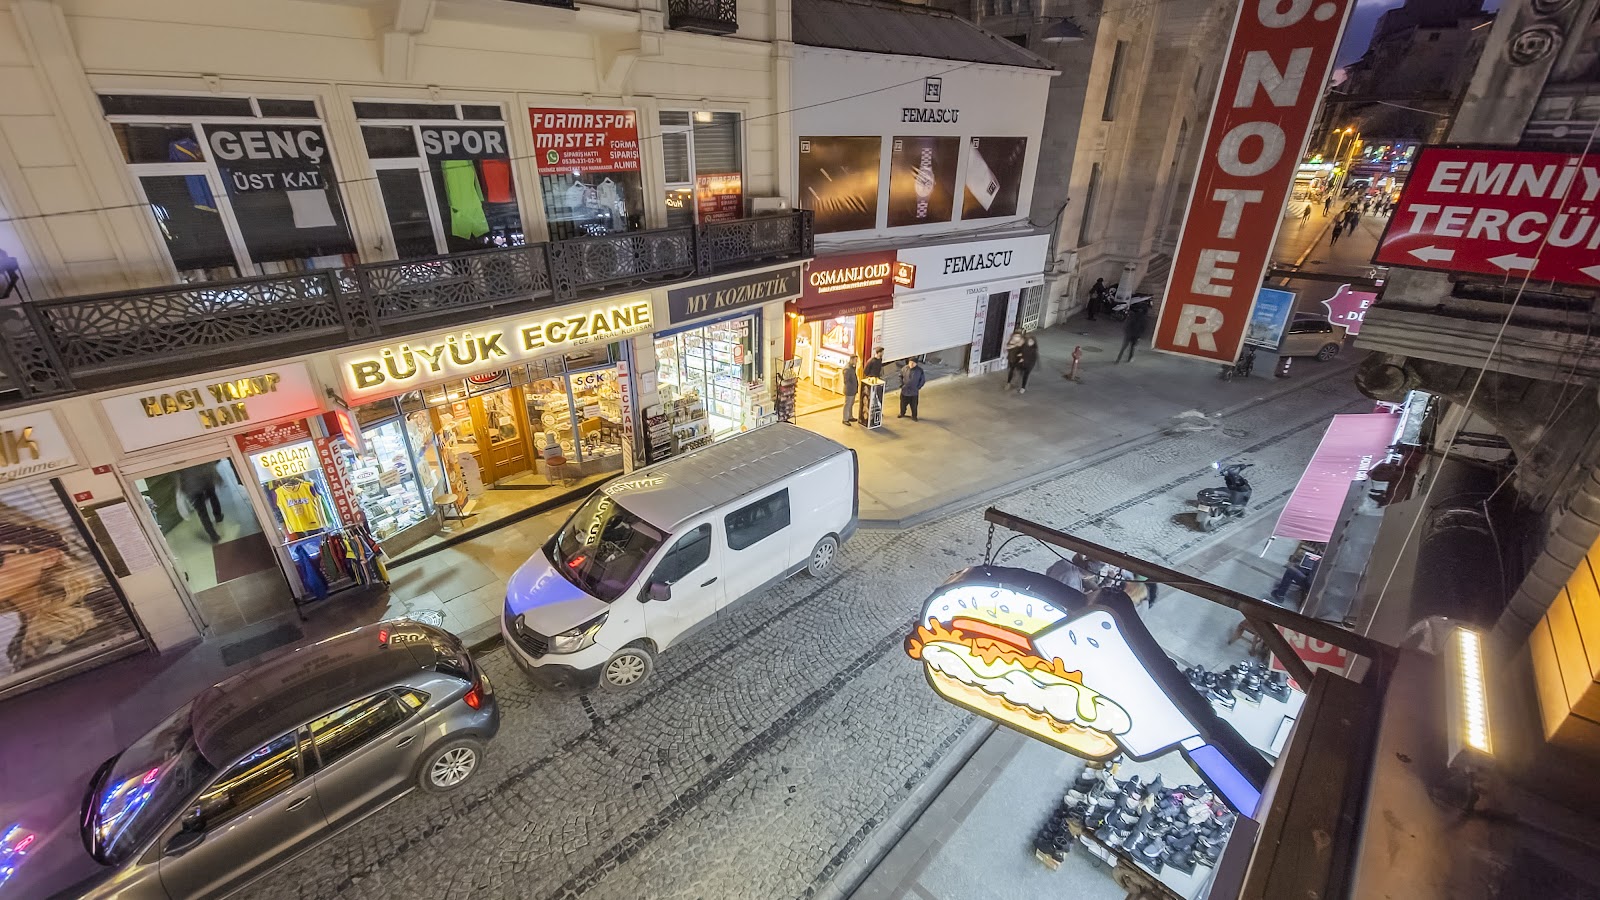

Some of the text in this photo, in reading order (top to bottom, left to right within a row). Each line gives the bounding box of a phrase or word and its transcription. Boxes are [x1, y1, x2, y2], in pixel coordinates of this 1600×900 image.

[533, 113, 635, 129] FORMASPOR
[901, 107, 959, 123] FEMASCU
[210, 130, 324, 164] GENÇ
[423, 130, 504, 154] SPOR
[536, 133, 606, 148] MASTER
[610, 141, 637, 149] FORMA
[614, 160, 637, 169] ALINIR
[233, 171, 319, 191] ÜST KAT
[1173, 47, 1314, 352] NOTER
[943, 250, 1013, 275] FEMASCU
[810, 266, 864, 287] OSMANLI
[864, 262, 891, 279] OUD
[685, 292, 711, 315] MY
[714, 273, 789, 309] KOZMETİK
[351, 332, 507, 390] BÜYÜK
[521, 303, 650, 351] ECZANE
[593, 331, 619, 342] MERAL
[577, 373, 605, 386] SGK
[139, 387, 205, 418] HACI
[198, 402, 250, 430] HAN
[260, 446, 311, 468] SAĞLAM
[274, 460, 307, 477] SPOR
[332, 444, 358, 509] ECZANE
